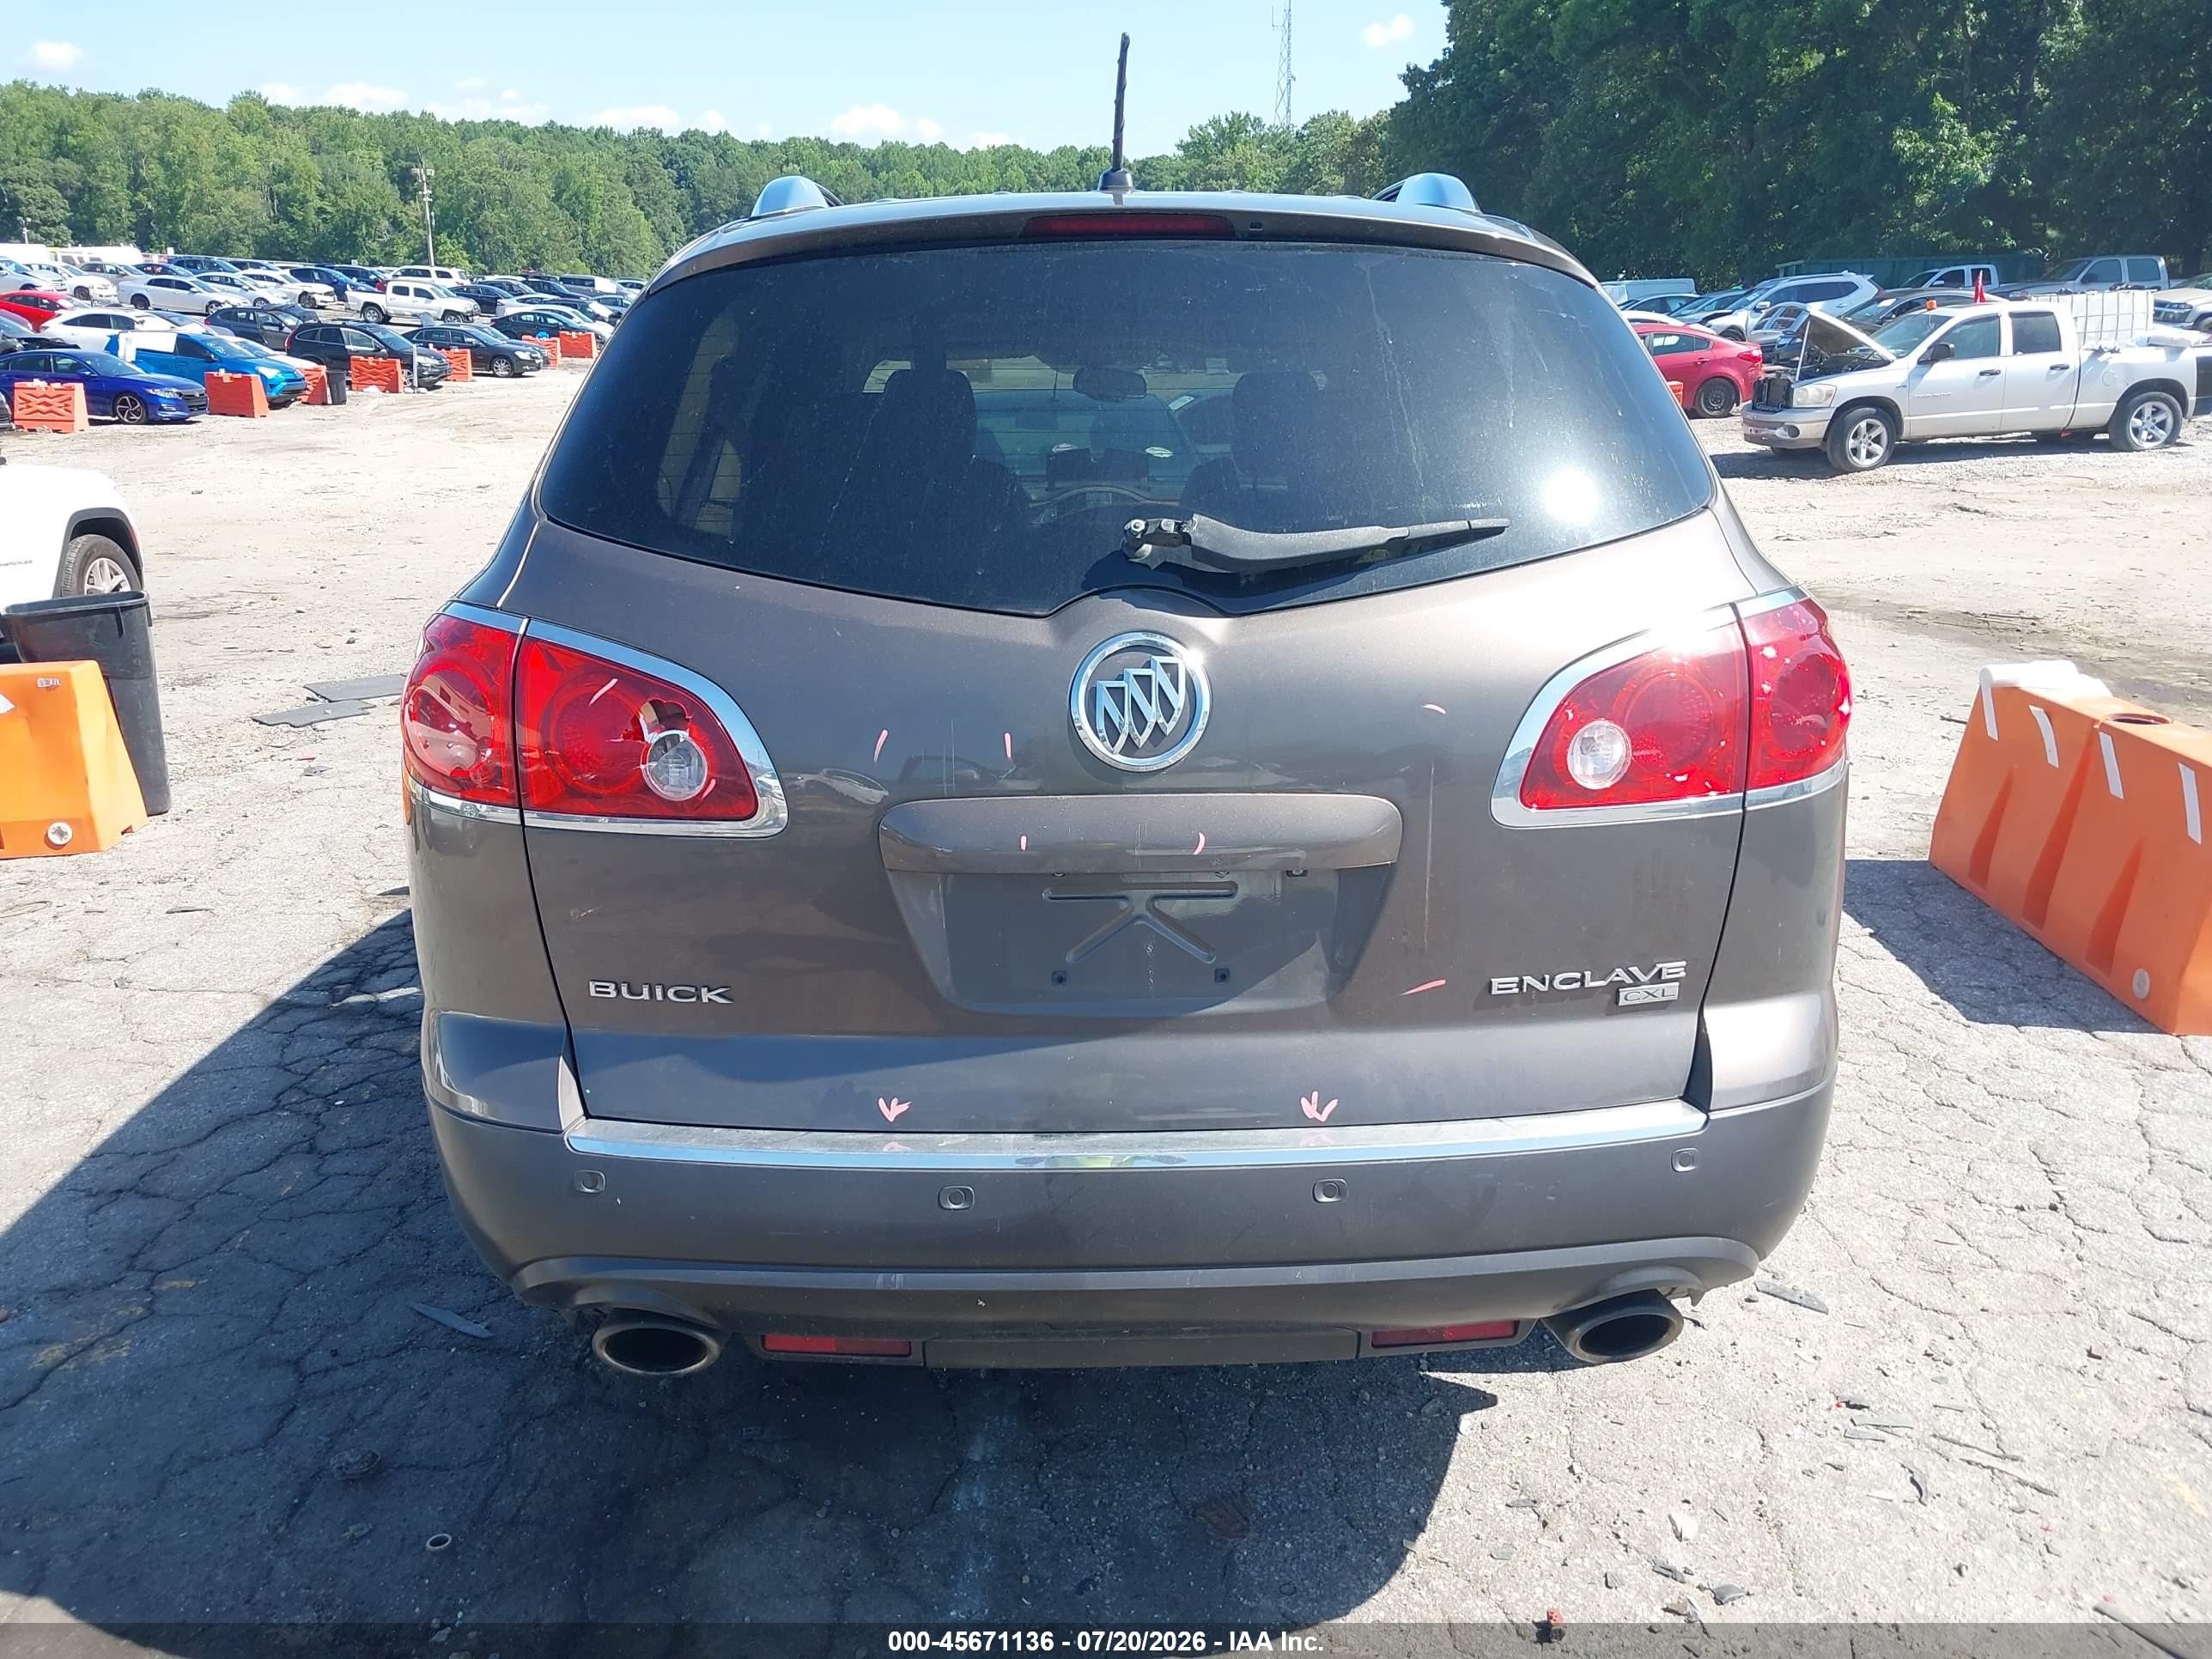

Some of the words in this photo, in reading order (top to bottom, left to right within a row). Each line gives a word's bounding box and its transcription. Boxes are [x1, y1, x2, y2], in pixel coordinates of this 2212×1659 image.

[1490, 961, 1687, 995] ENCLAVE
[588, 981, 733, 1004] BUICK
[1624, 987, 1675, 1003] CXL
